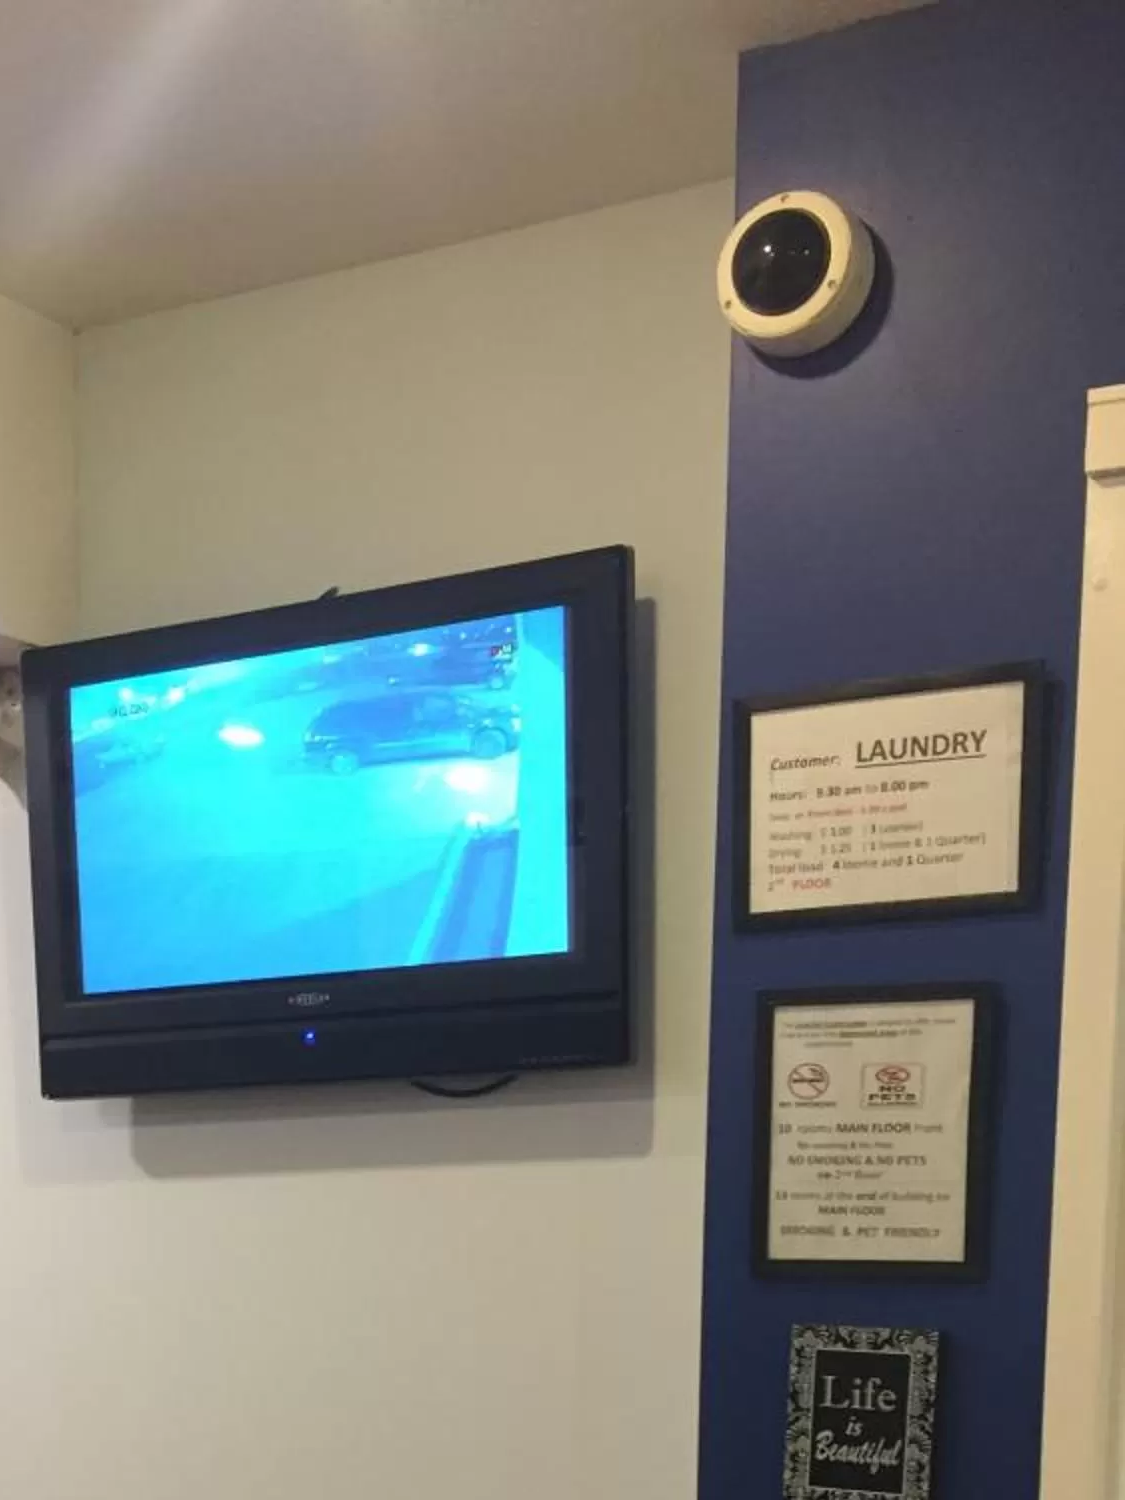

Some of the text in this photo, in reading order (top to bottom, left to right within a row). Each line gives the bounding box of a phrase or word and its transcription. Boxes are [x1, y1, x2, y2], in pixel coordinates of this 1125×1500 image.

[856, 729, 988, 764] LAUNDRY
[832, 860, 841, 870] 4
[791, 877, 832, 890] FLOOR
[834, 1121, 869, 1134] MAIN
[870, 1121, 912, 1135] FLOOR
[787, 1154, 805, 1166] NO
[806, 1154, 862, 1166] SMOKING
[876, 1154, 894, 1166] NO
[896, 1154, 927, 1166] PETS
[818, 1204, 848, 1215] MAIN
[819, 1375, 897, 1412] Life
[845, 1415, 864, 1437] is
[814, 1428, 903, 1475] Beautiful
